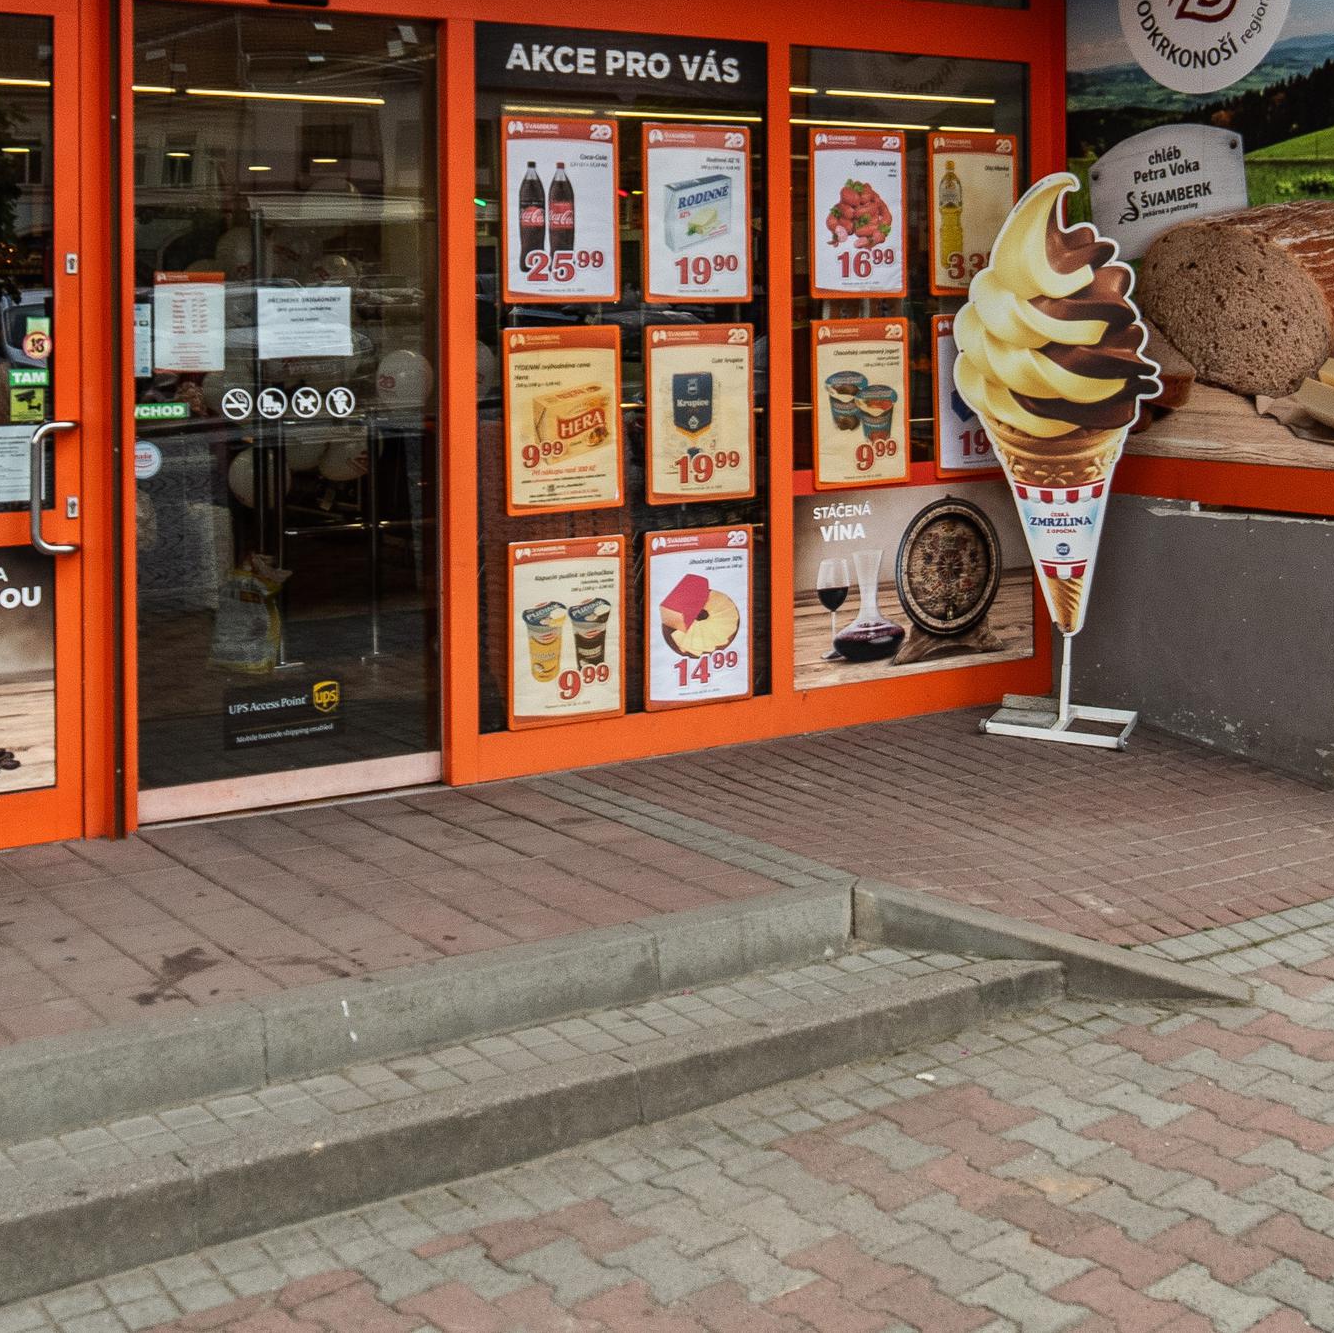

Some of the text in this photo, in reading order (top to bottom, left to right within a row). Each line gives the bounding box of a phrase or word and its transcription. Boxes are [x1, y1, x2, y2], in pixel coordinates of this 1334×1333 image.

[505, 43, 741, 84] AKCE PRO VÁS
[1148, 146, 1181, 165] chléb
[1134, 160, 1200, 184] Petra Voka
[1140, 181, 1212, 208] ŠVAMBERK
[12, 372, 46, 384] TAM
[560, 411, 604, 438] HERA
[813, 500, 871, 520] STÁČENÁ
[1029, 516, 1093, 527] ZMRZLINA
[820, 522, 866, 542] VÍNA
[228, 704, 249, 715] UPS
[249, 699, 280, 712] Access
[314, 689, 338, 708] ups
